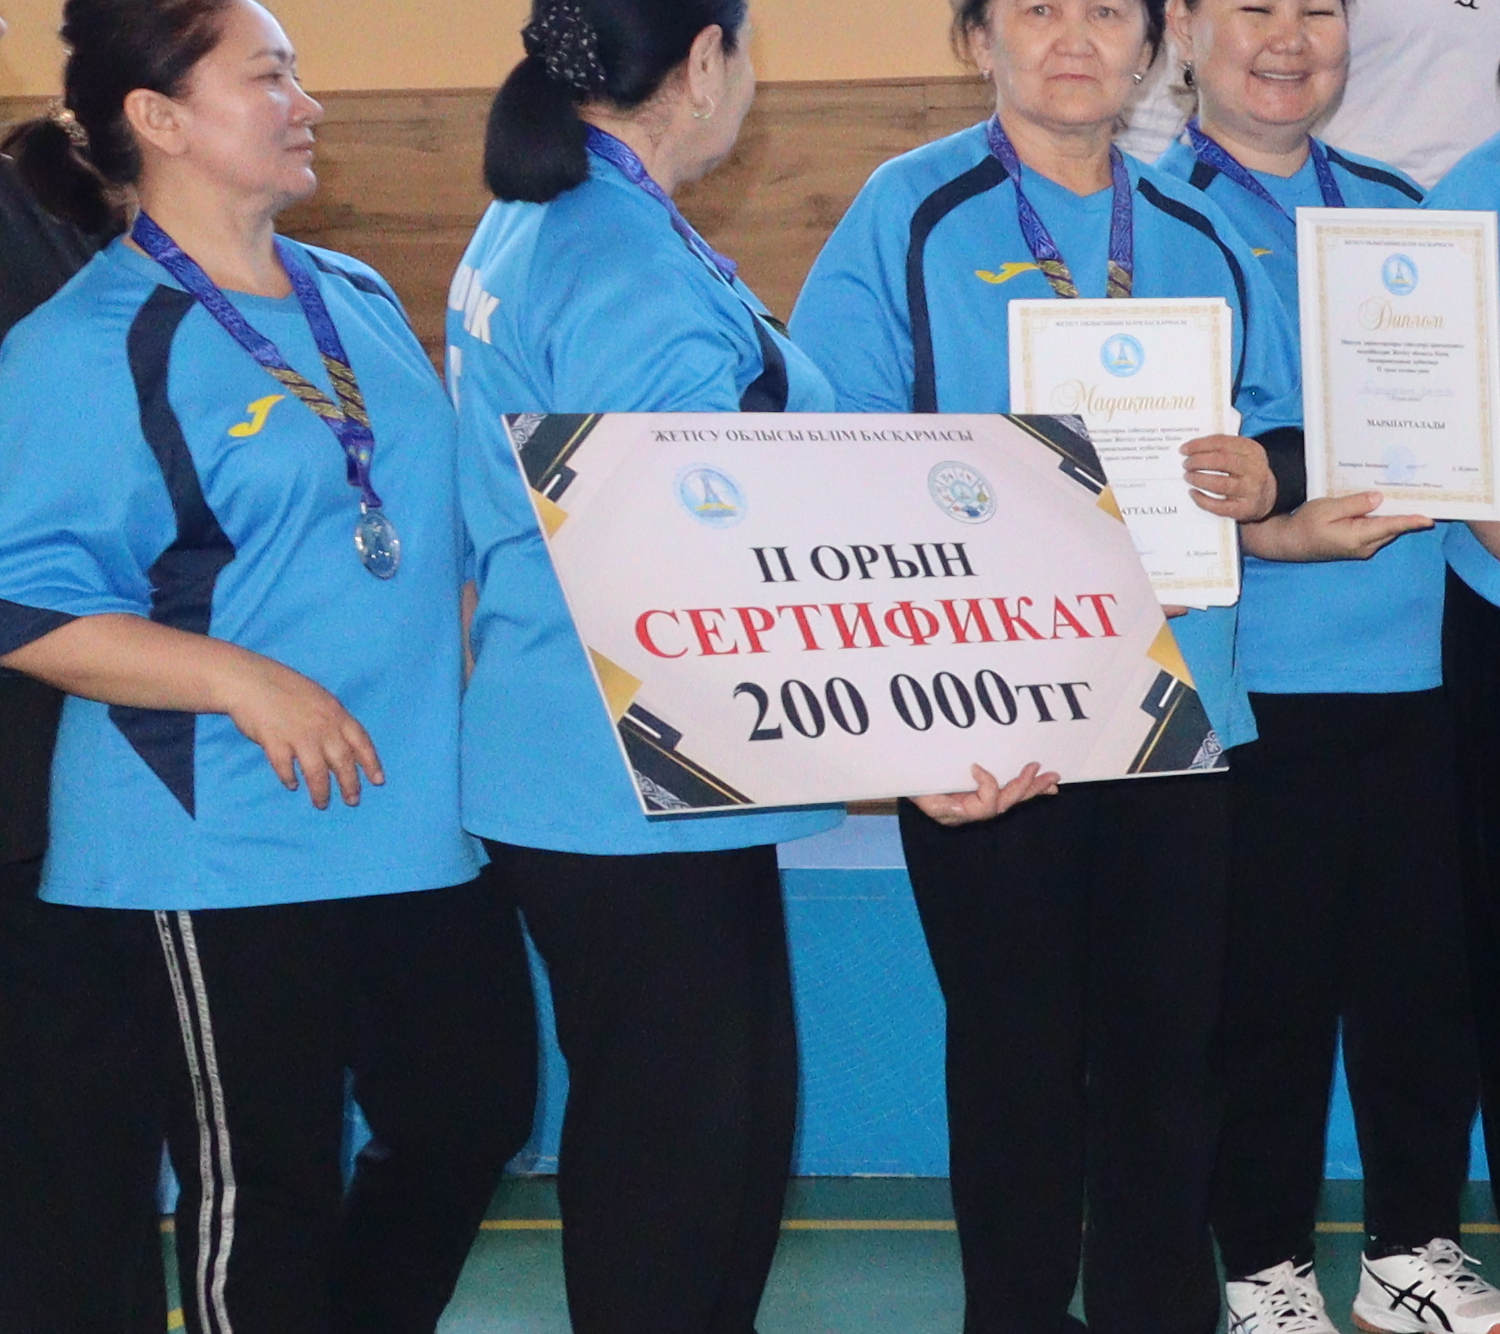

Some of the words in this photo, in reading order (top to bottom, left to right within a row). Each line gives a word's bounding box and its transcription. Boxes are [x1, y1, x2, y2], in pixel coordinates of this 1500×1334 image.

[653, 429, 720, 443] ЖЕТІСУ
[725, 428, 802, 443] ОБЛЫСЫ
[807, 428, 857, 443] БІЛІМ
[748, 545, 800, 583] II
[809, 542, 979, 582] ОРЫН
[634, 593, 1123, 659] СЕРТИФИКАТ
[732, 676, 871, 742] 200
